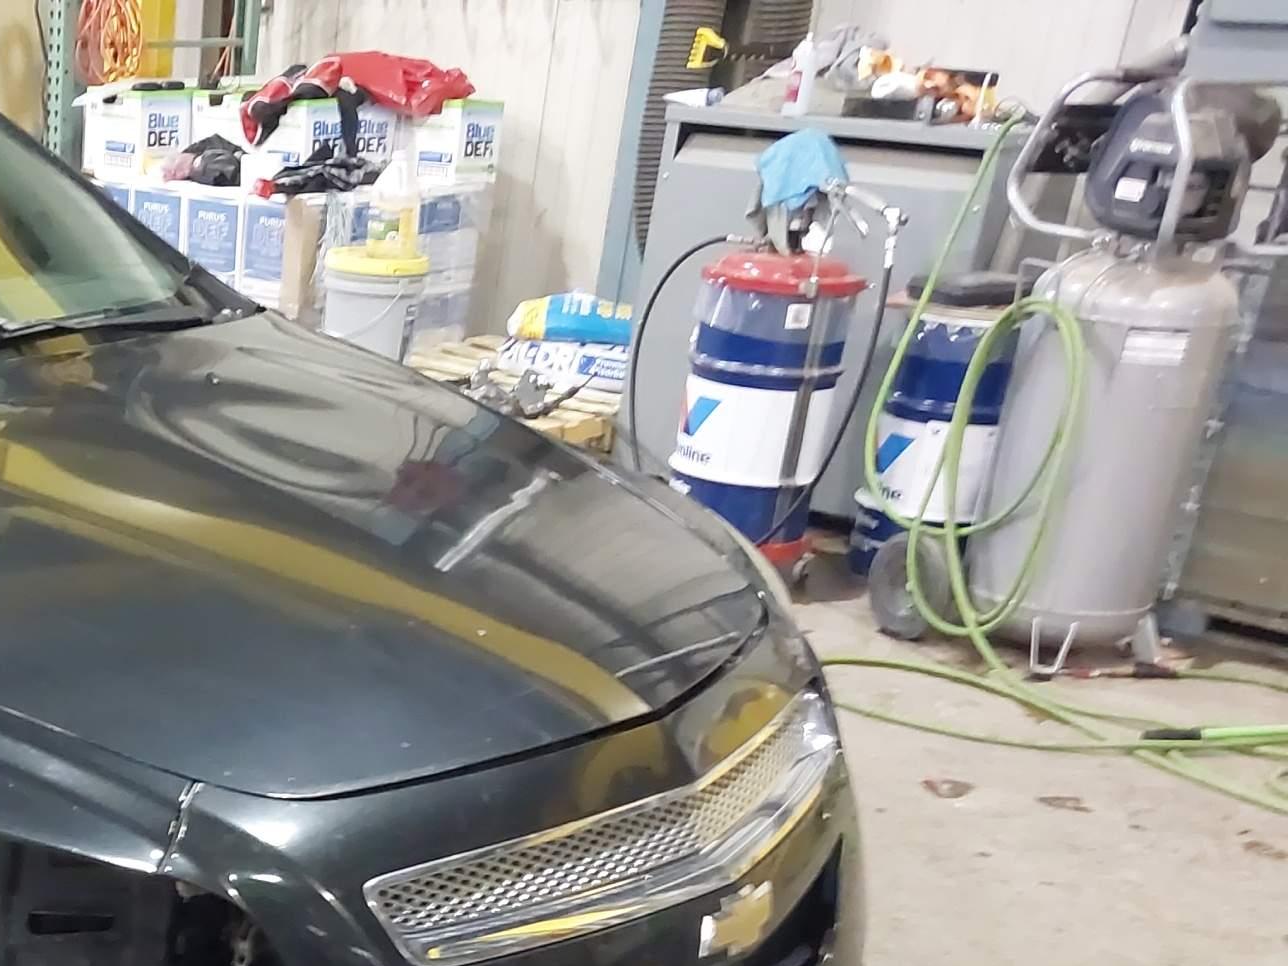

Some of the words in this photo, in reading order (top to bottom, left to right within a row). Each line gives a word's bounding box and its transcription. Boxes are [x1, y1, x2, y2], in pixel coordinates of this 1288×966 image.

[148, 112, 179, 129] Blue
[147, 130, 179, 147] DEF
[357, 136, 387, 153] DEF
[464, 140, 494, 157] DEF
